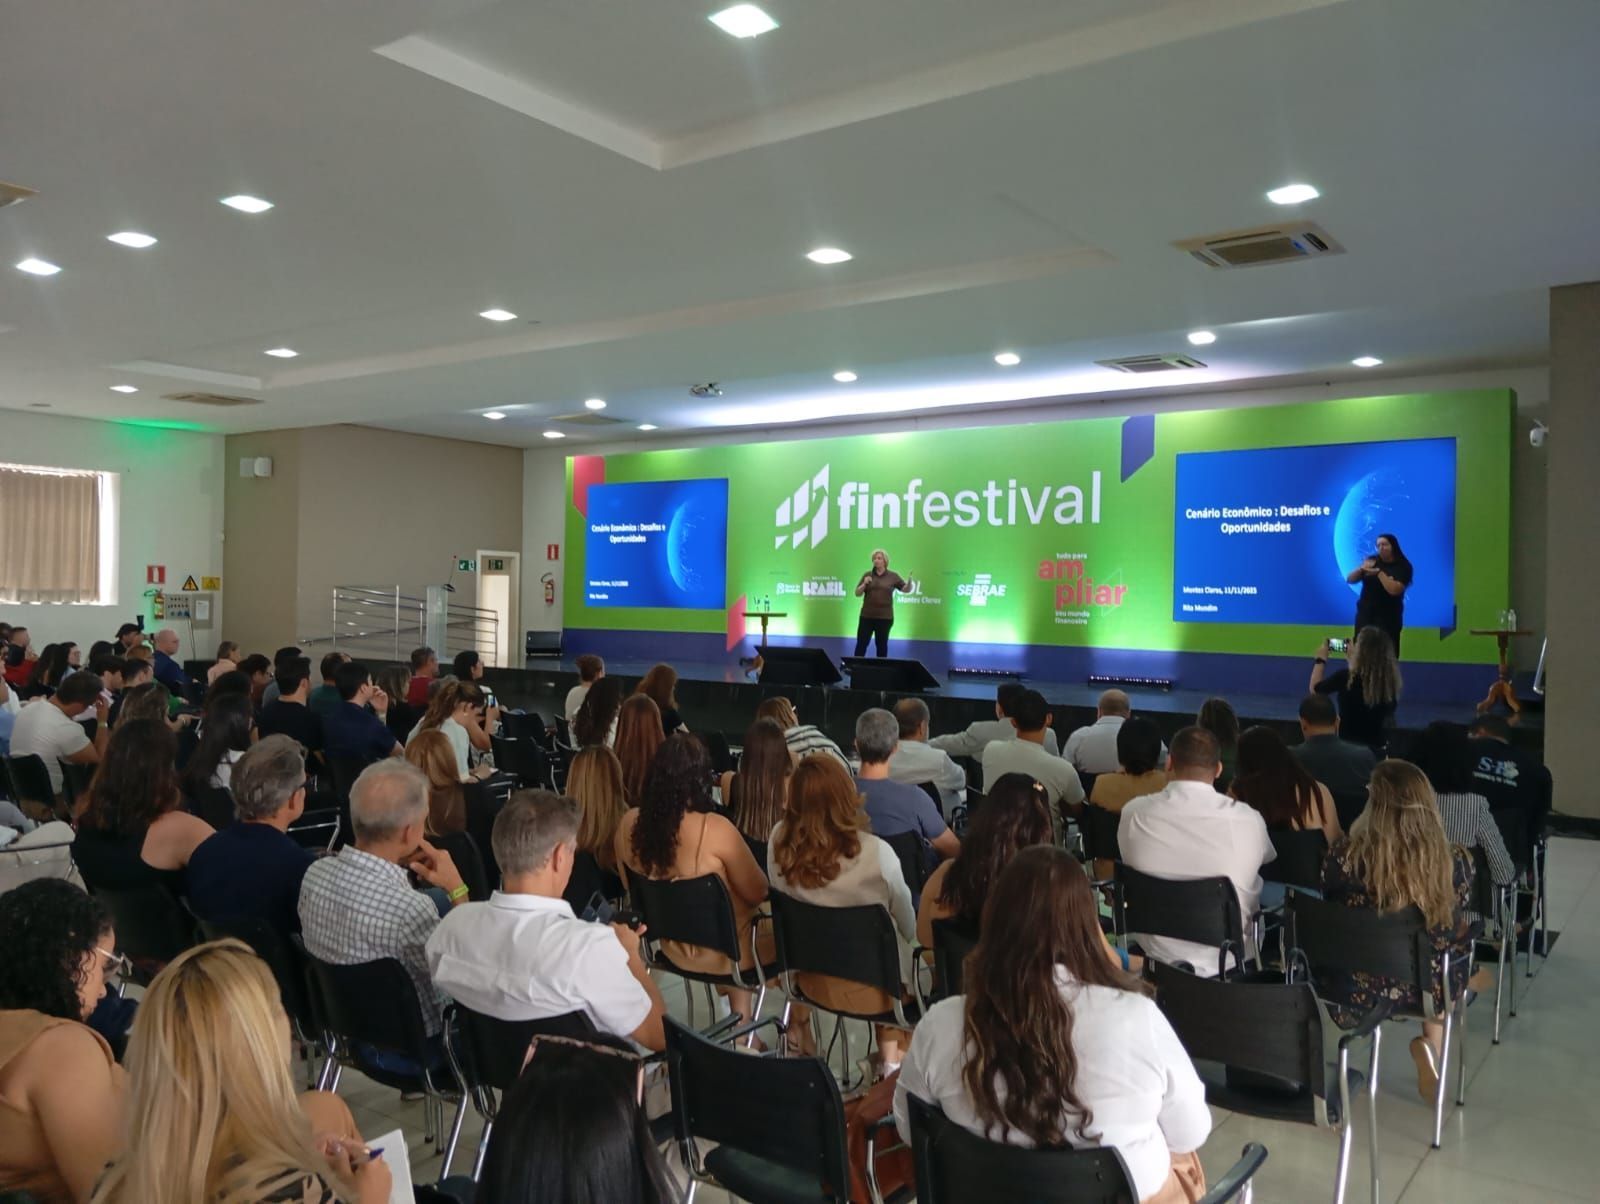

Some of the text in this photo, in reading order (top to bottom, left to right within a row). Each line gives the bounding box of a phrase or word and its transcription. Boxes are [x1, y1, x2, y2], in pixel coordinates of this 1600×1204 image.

[837, 470, 1101, 530] finfestival
[1185, 507, 1221, 519] Cenário
[1222, 506, 1273, 518] Econômico
[1280, 504, 1322, 517] Desafios
[1323, 506, 1331, 516] e
[1221, 521, 1292, 535] Oportunidades
[1039, 559, 1084, 580] am
[802, 581, 846, 597] BRASIL
[956, 584, 1007, 597] SEBRAE
[1056, 577, 1128, 611] pliar
